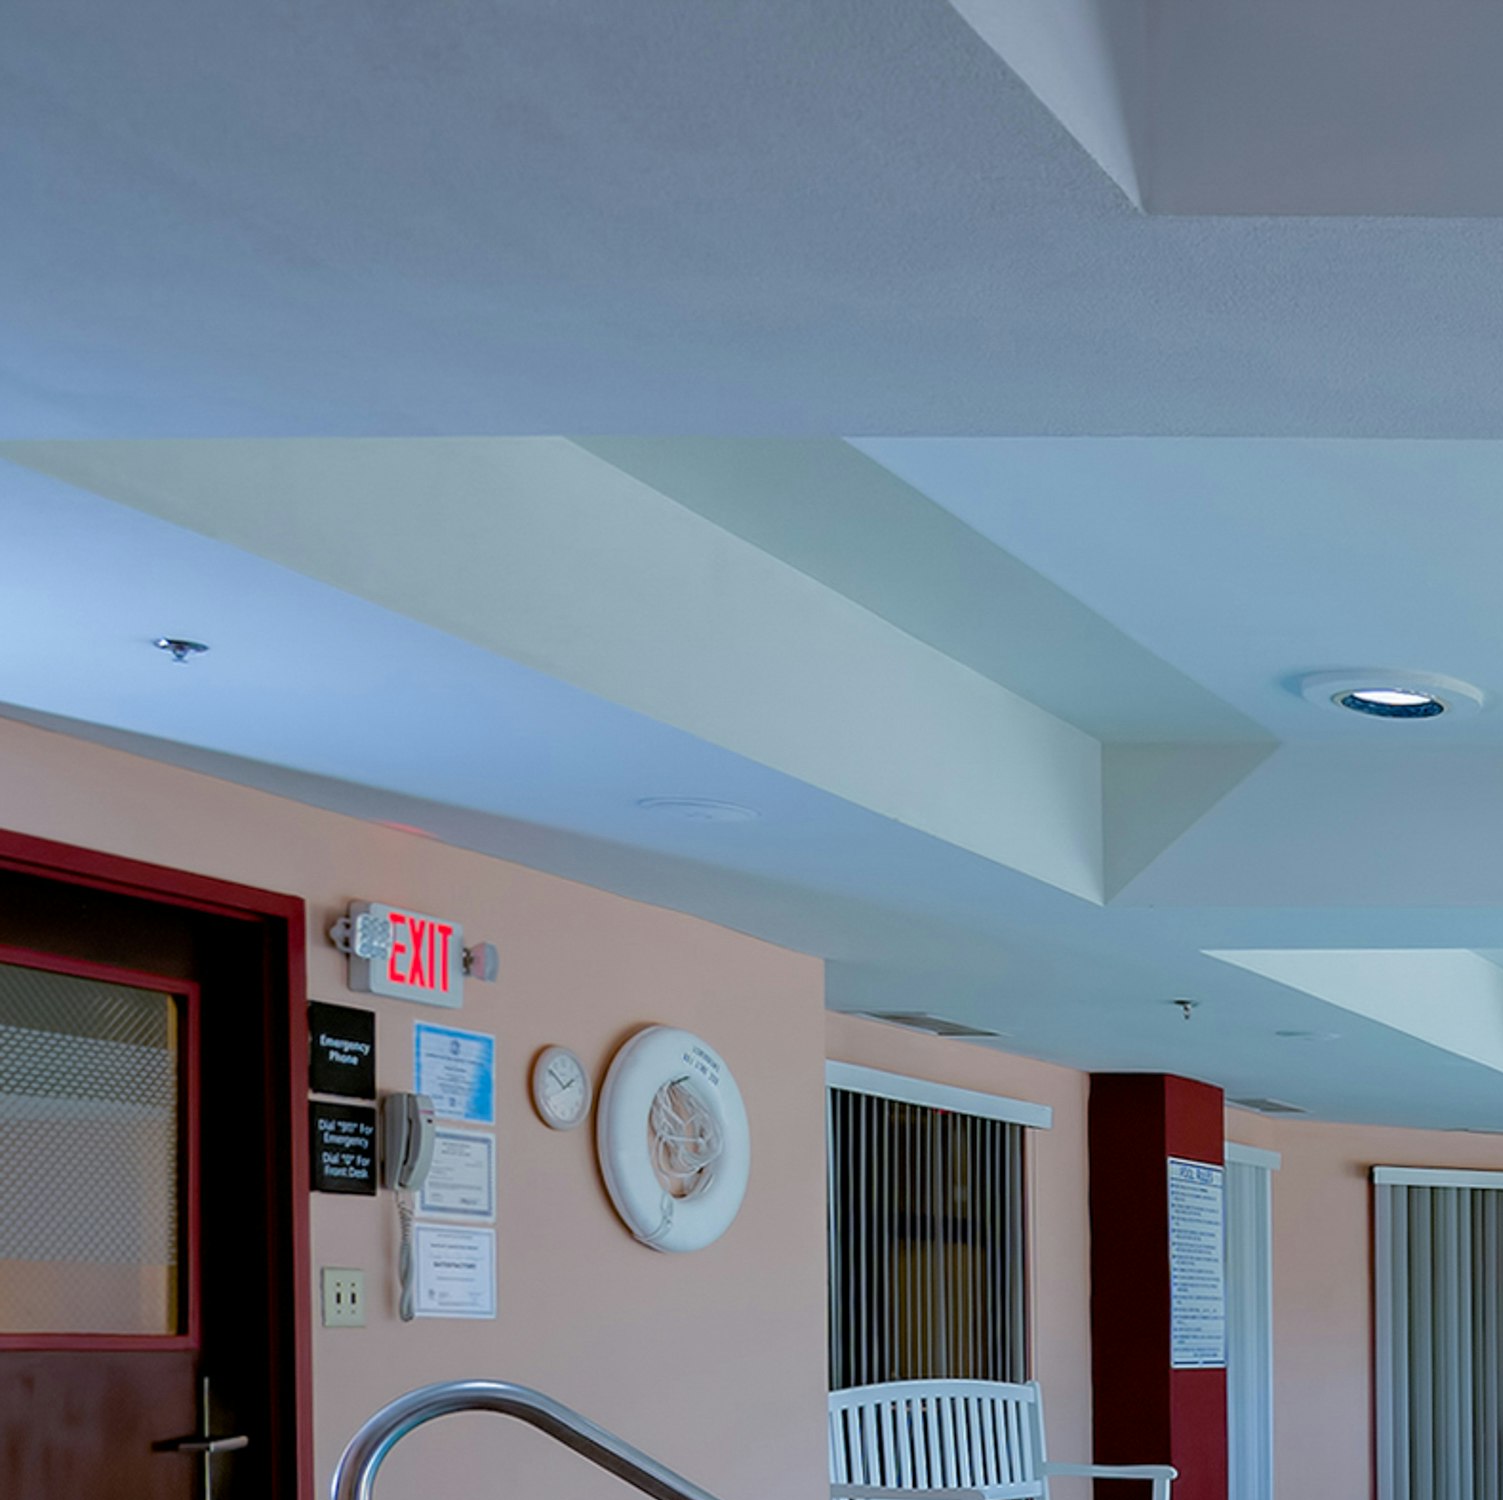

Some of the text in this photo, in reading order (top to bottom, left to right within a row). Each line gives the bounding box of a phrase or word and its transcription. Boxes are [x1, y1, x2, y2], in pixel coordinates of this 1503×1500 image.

[387, 911, 453, 993] EXIT
[319, 1033, 370, 1056] Emergency
[329, 1049, 359, 1066] Phone
